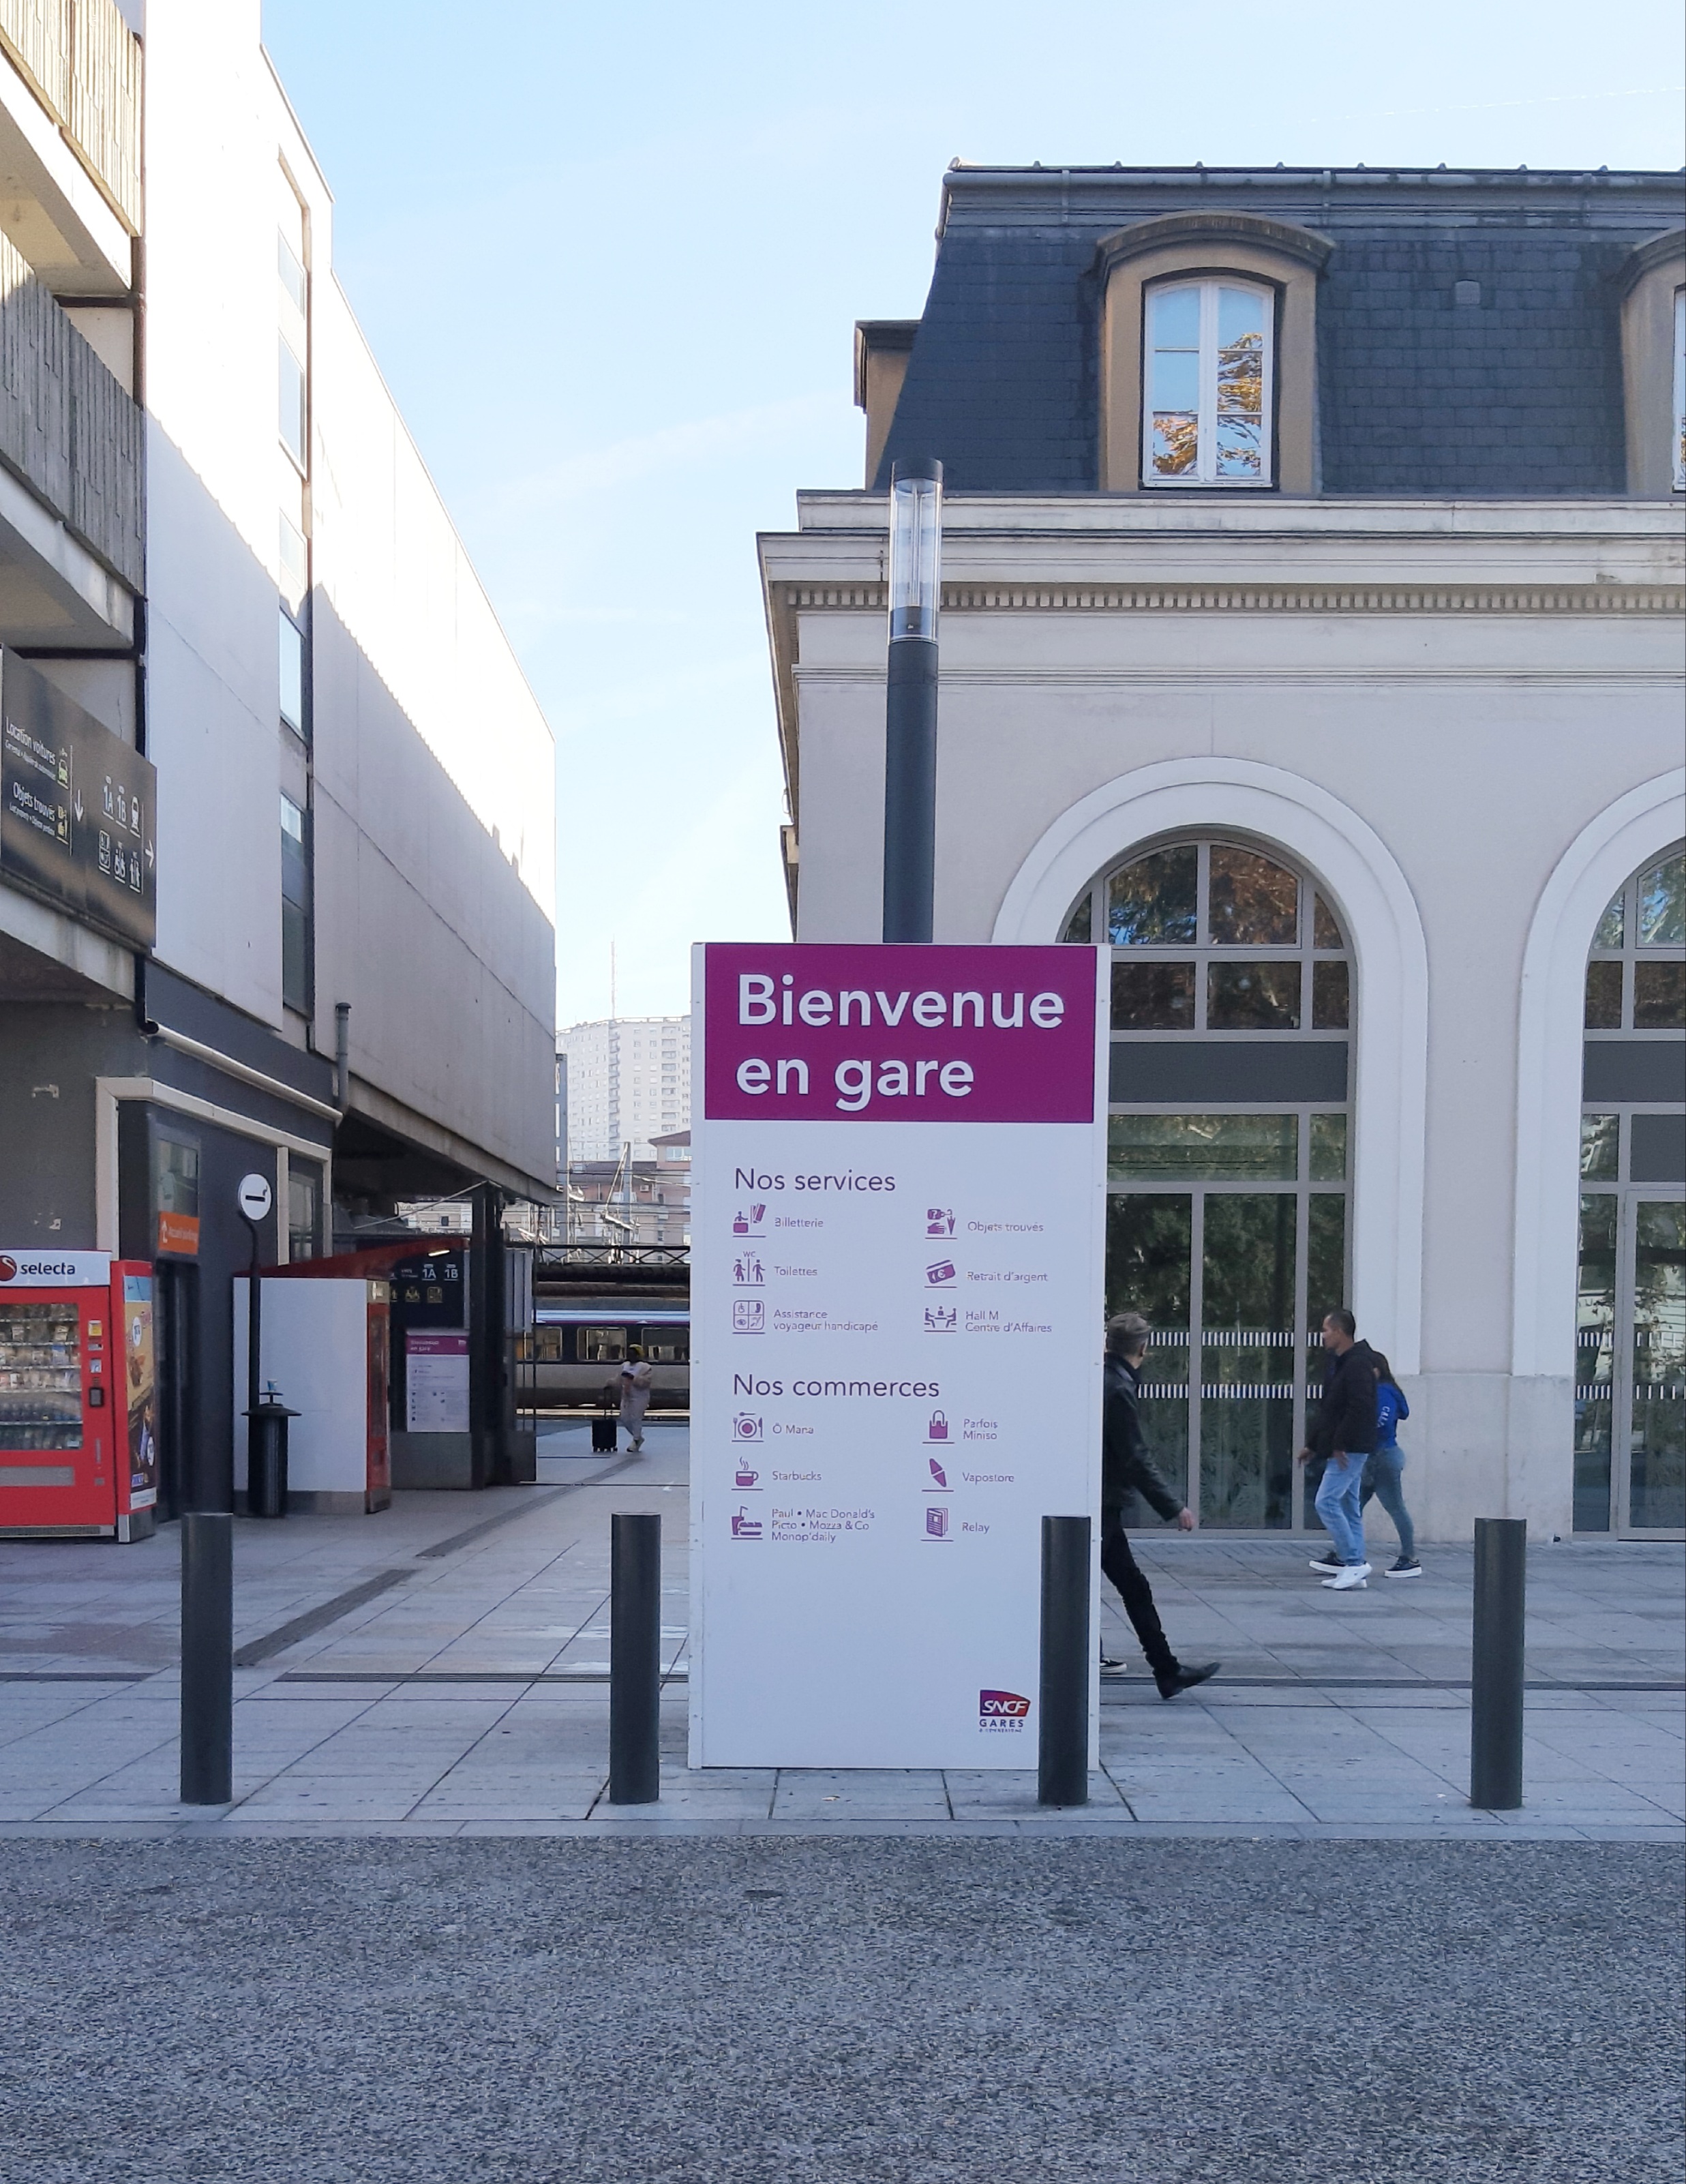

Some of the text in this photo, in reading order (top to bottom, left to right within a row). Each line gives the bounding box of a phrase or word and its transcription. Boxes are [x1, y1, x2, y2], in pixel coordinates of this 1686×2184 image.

[5, 716, 32, 749] Location
[13, 781, 33, 808] Objets
[104, 785, 127, 822] 1A 1B
[739, 974, 1065, 1028] Bienvenue
[736, 1058, 974, 1111] en gare
[735, 1167, 896, 1191] Nos services
[774, 1216, 824, 1228] Billetterie
[967, 1221, 1044, 1234] Objets trouvés
[20, 1262, 76, 1274] selecta
[423, 1268, 436, 1278] 1A
[445, 1268, 458, 1278] 1B
[773, 1266, 818, 1276] Toilettes
[967, 1271, 1002, 1281] Retrait
[773, 1308, 828, 1321] Assistance
[965, 1310, 999, 1321] Hall M
[773, 1319, 878, 1334] voyageur handicapé
[965, 1321, 1001, 1332] Centre
[734, 1373, 939, 1397] Nos commerces
[963, 1418, 998, 1430] Parfois
[963, 1428, 997, 1440] Miniso
[772, 1470, 822, 1481] Starbucks
[962, 1471, 1014, 1486] Vapostore
[772, 1508, 794, 1519] Paul
[806, 1508, 828, 1520] Mac
[771, 1519, 870, 1531] Picto Mozza & Co
[962, 1522, 990, 1535] Relay
[982, 1699, 1028, 1714] SNCF
[979, 1719, 1024, 1728] GARES
